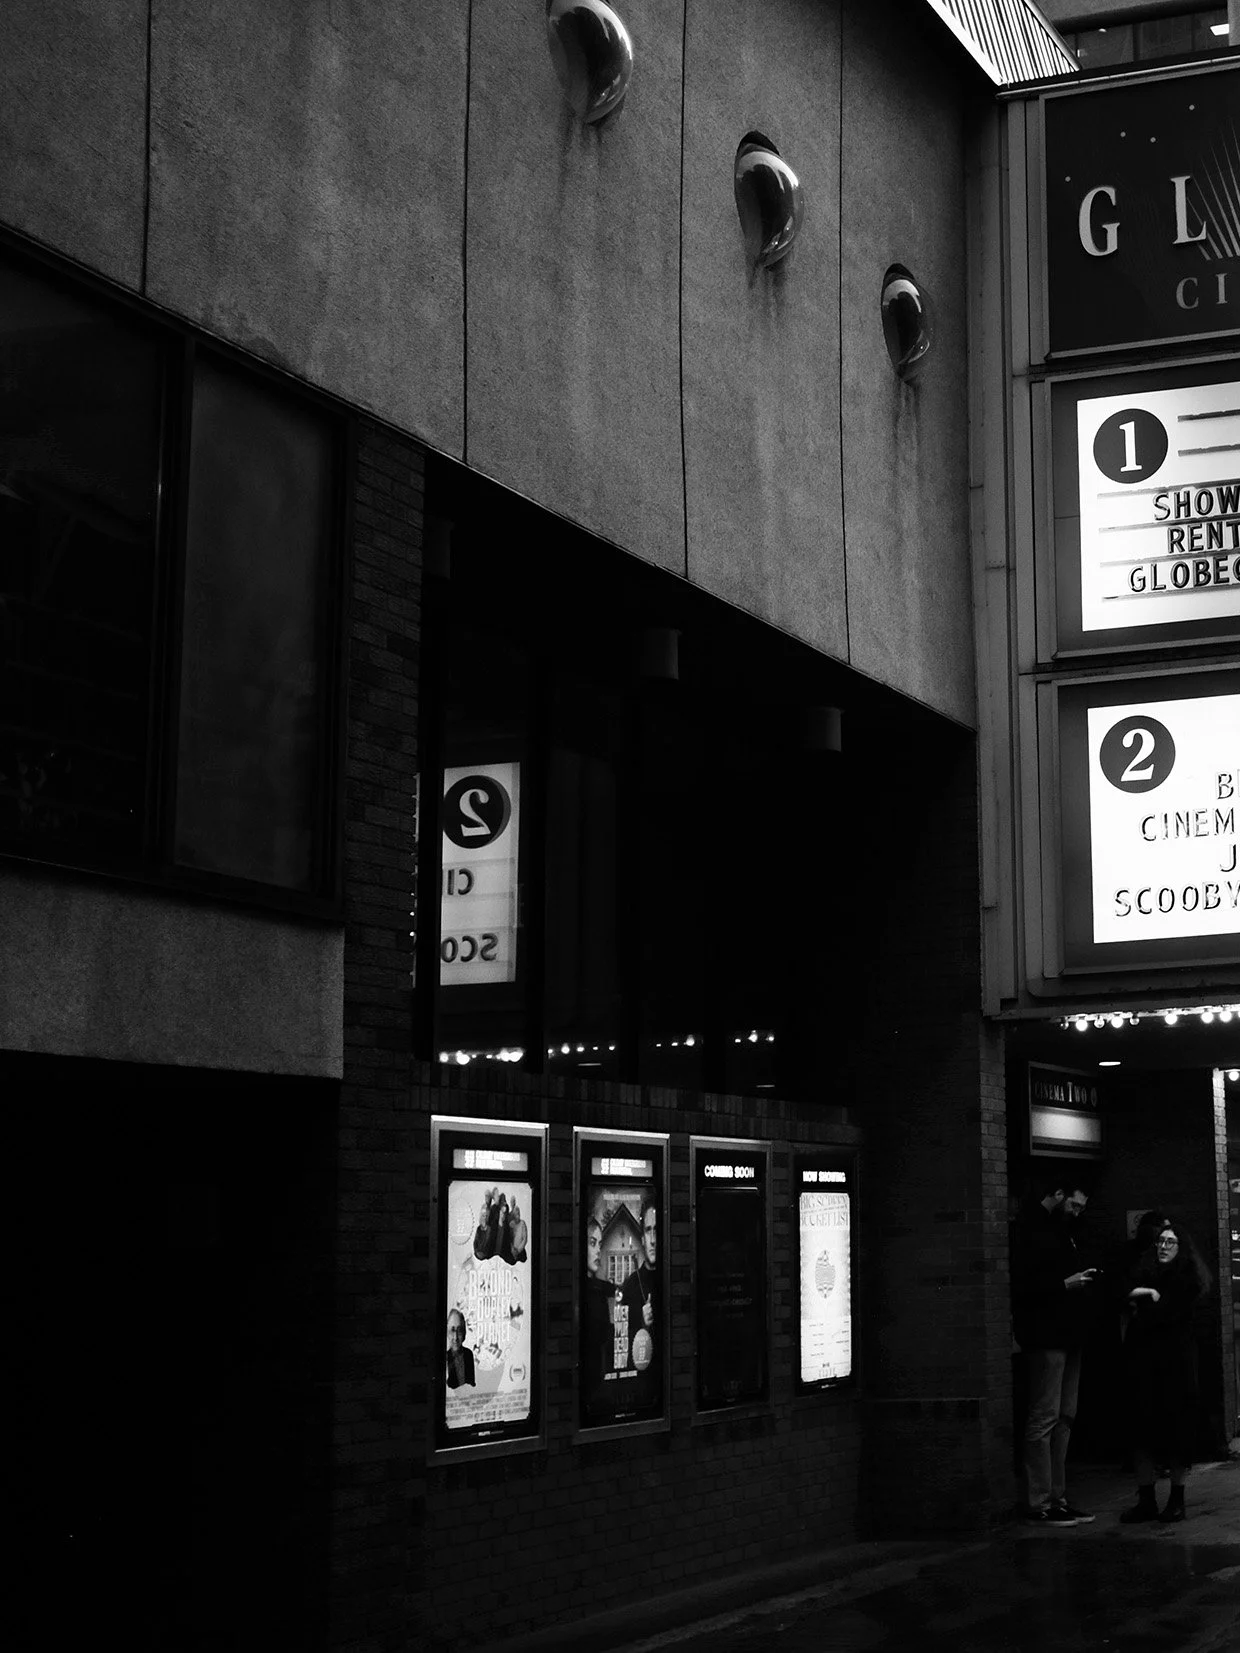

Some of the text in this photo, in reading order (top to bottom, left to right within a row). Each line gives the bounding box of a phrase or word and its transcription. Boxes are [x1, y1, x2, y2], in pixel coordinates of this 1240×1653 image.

[1119, 421, 1143, 472] 1
[1120, 728, 1155, 782] 2
[1034, 1081, 1087, 1104] CINEMA TWO
[704, 1165, 755, 1179] COMING SOON
[802, 1170, 846, 1183] NOW SHOWING
